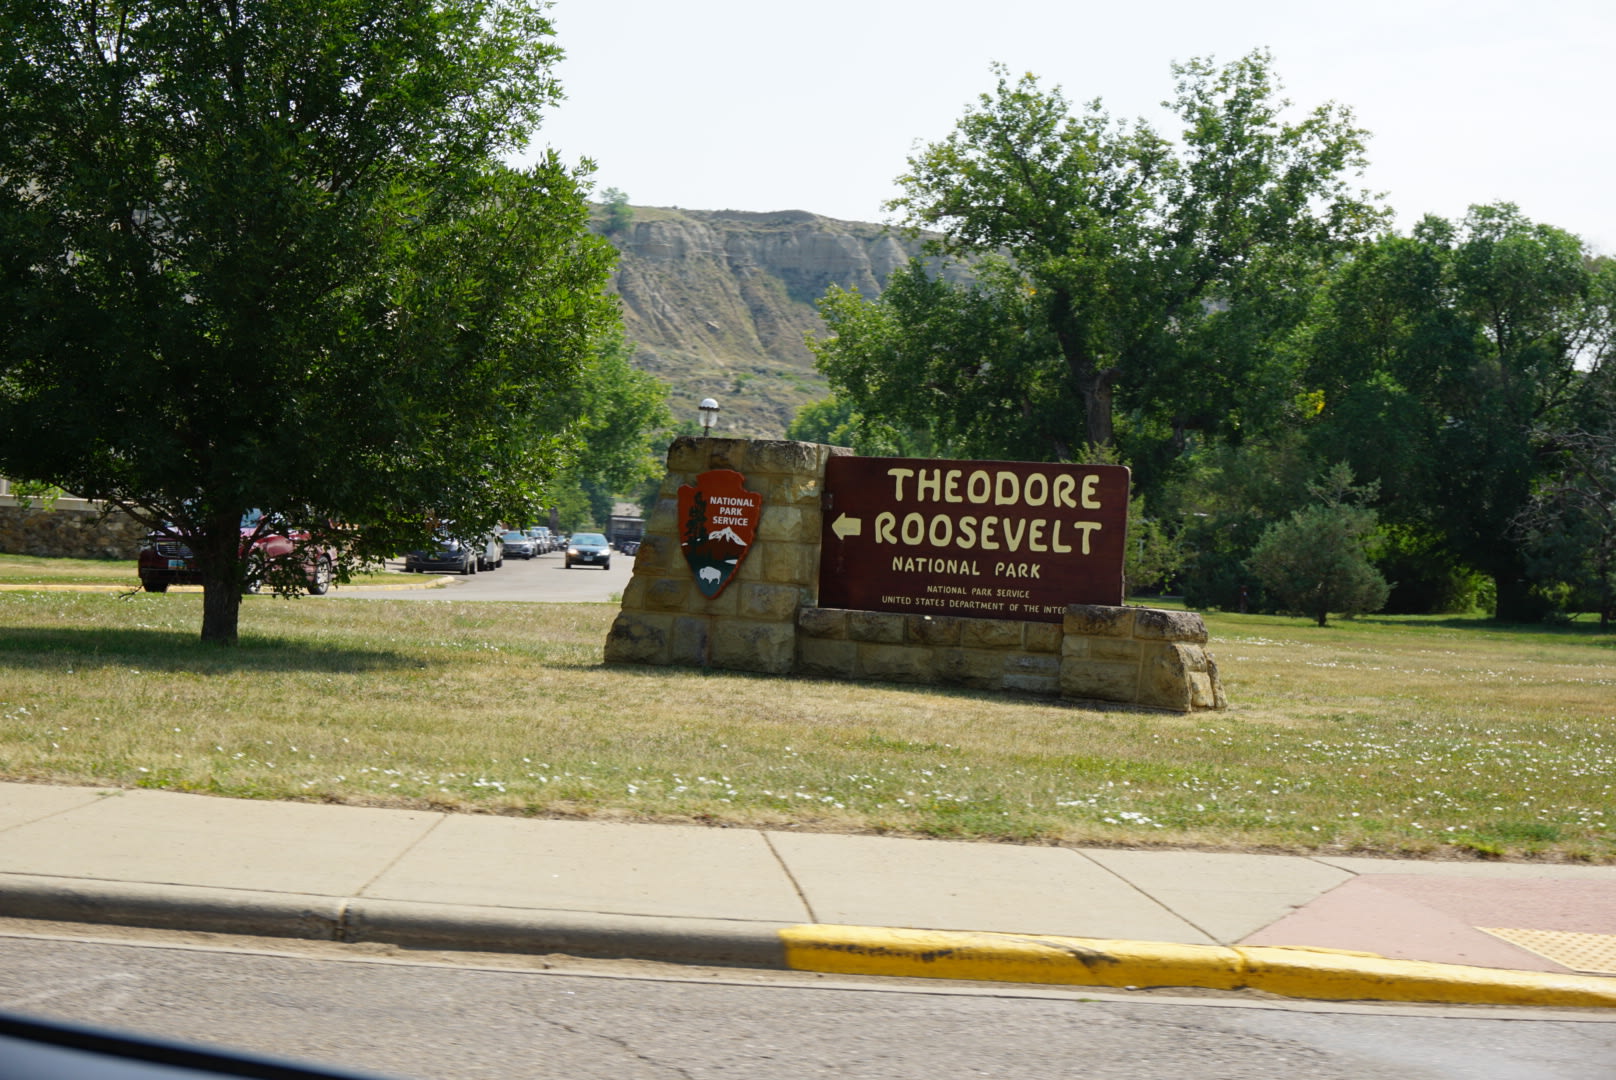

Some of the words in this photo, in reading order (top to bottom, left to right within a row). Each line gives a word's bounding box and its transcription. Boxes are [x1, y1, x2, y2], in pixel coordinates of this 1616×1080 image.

[888, 468, 1101, 509] THEODORE
[710, 496, 754, 507] NATIONAL
[720, 507, 742, 516] PARK
[713, 516, 748, 526] SERVICE
[875, 512, 1102, 555] ROOSEVELT
[892, 556, 981, 576] NATIONAL
[994, 561, 1041, 579] PARK
[927, 585, 967, 595] NATIONAL
[971, 587, 992, 597] PARK
[996, 589, 1030, 599] SERVICE
[882, 595, 912, 605] UNITED
[915, 597, 945, 607] STATES
[949, 599, 1004, 611] DEPARTMENT
[1009, 603, 1019, 612] OF
[1023, 604, 1039, 613] THE
